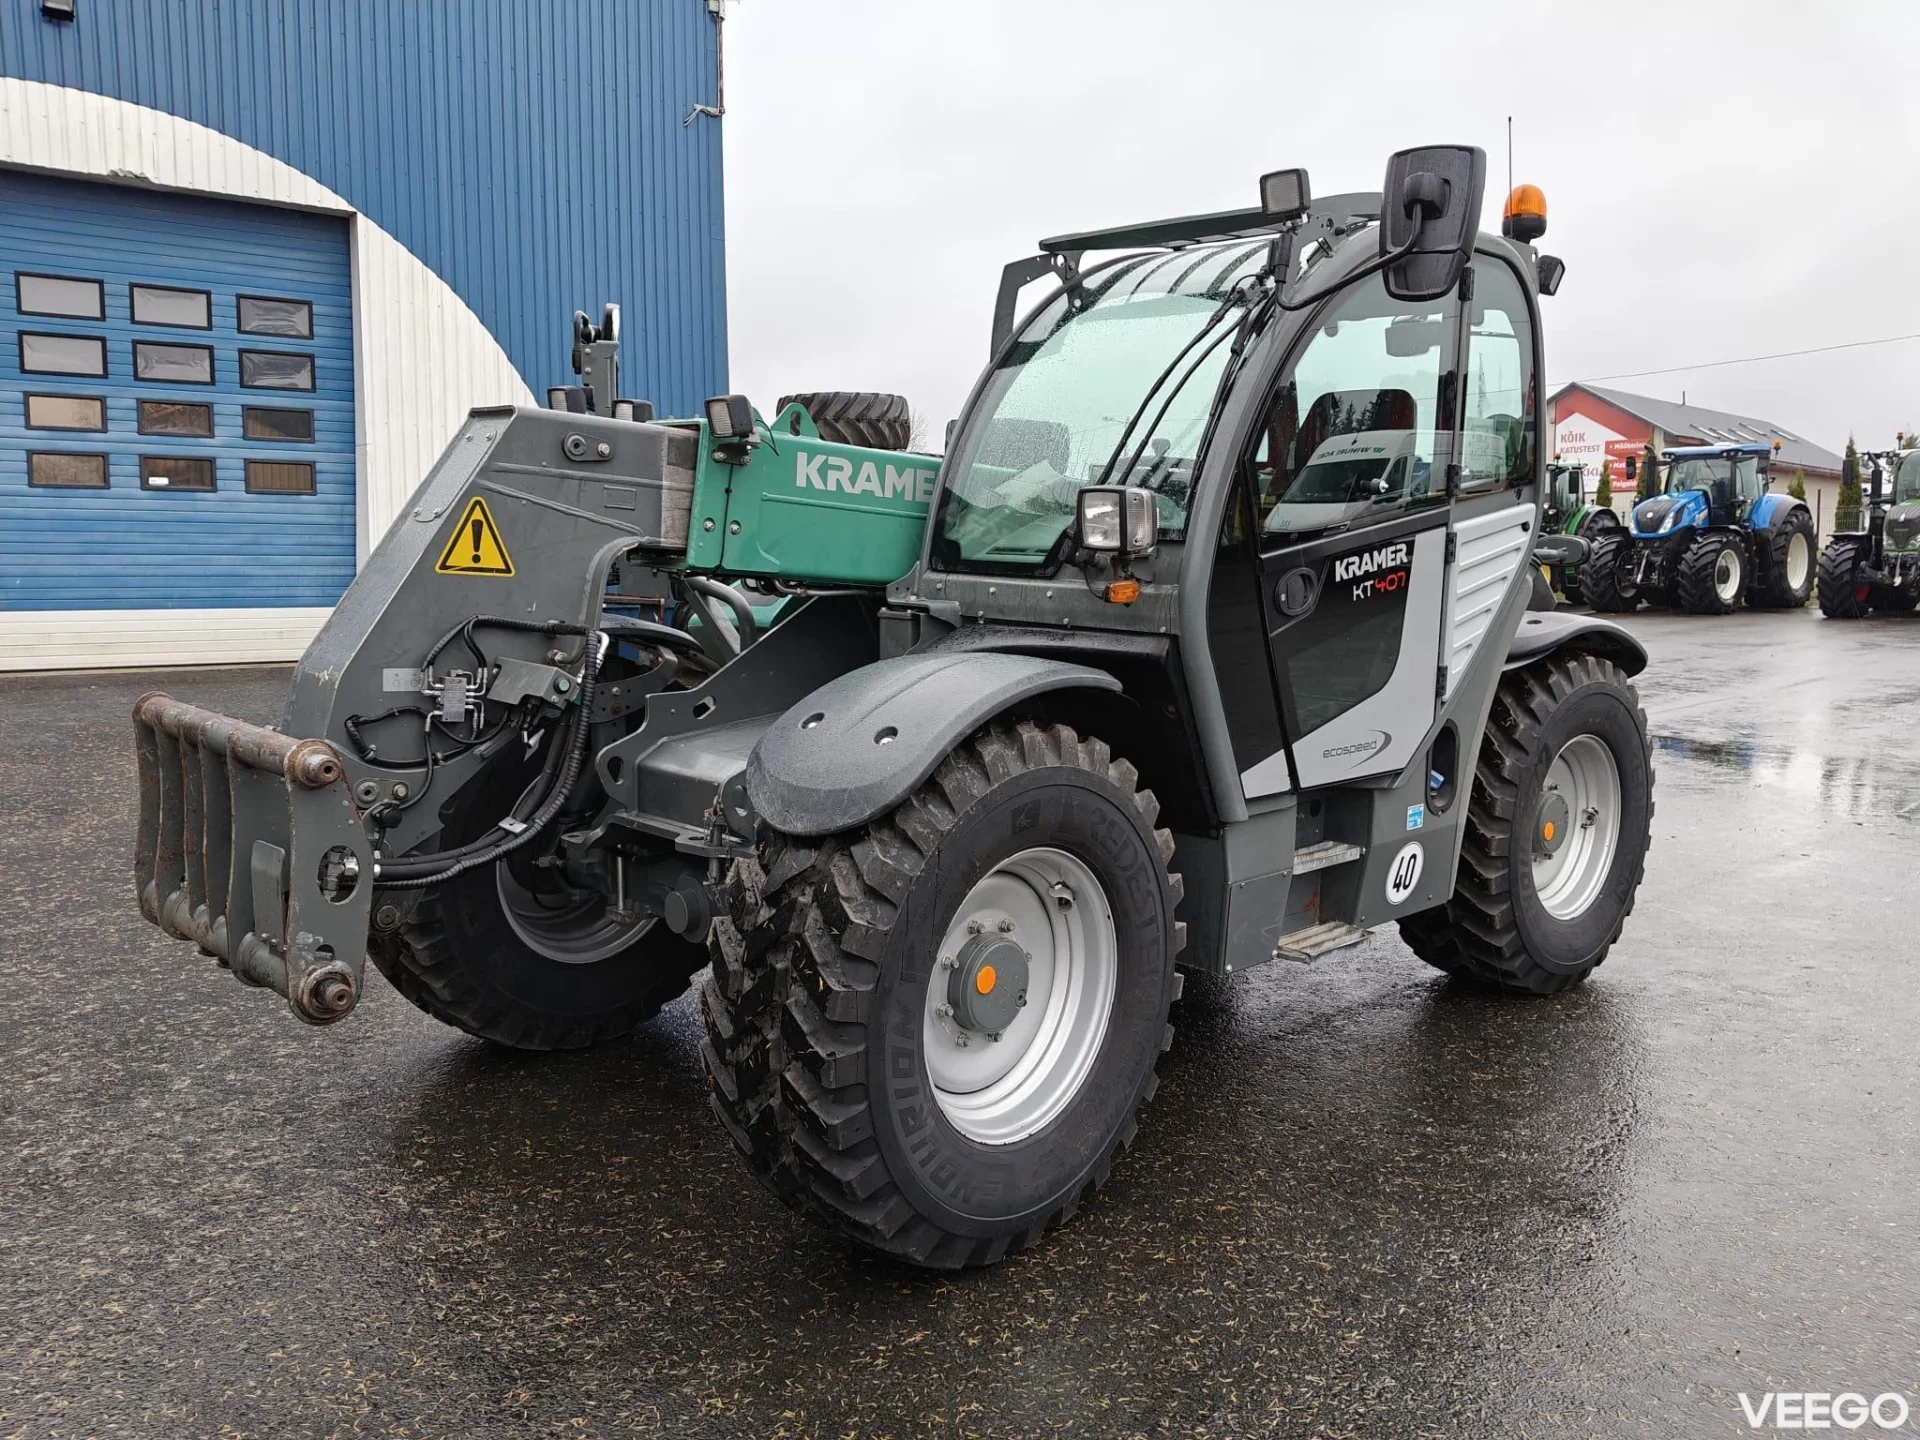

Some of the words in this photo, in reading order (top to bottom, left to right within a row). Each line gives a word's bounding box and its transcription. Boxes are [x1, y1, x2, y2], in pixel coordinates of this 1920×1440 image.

[1560, 430, 1586, 444] KÕIK
[1560, 444, 1601, 454] KATUSTEST
[795, 451, 936, 504] KRAME
[1335, 543, 1408, 583] KRAMER
[1353, 571, 1406, 602] KT407
[1322, 739, 1377, 759] ecospeed
[1392, 853, 1417, 893] 40
